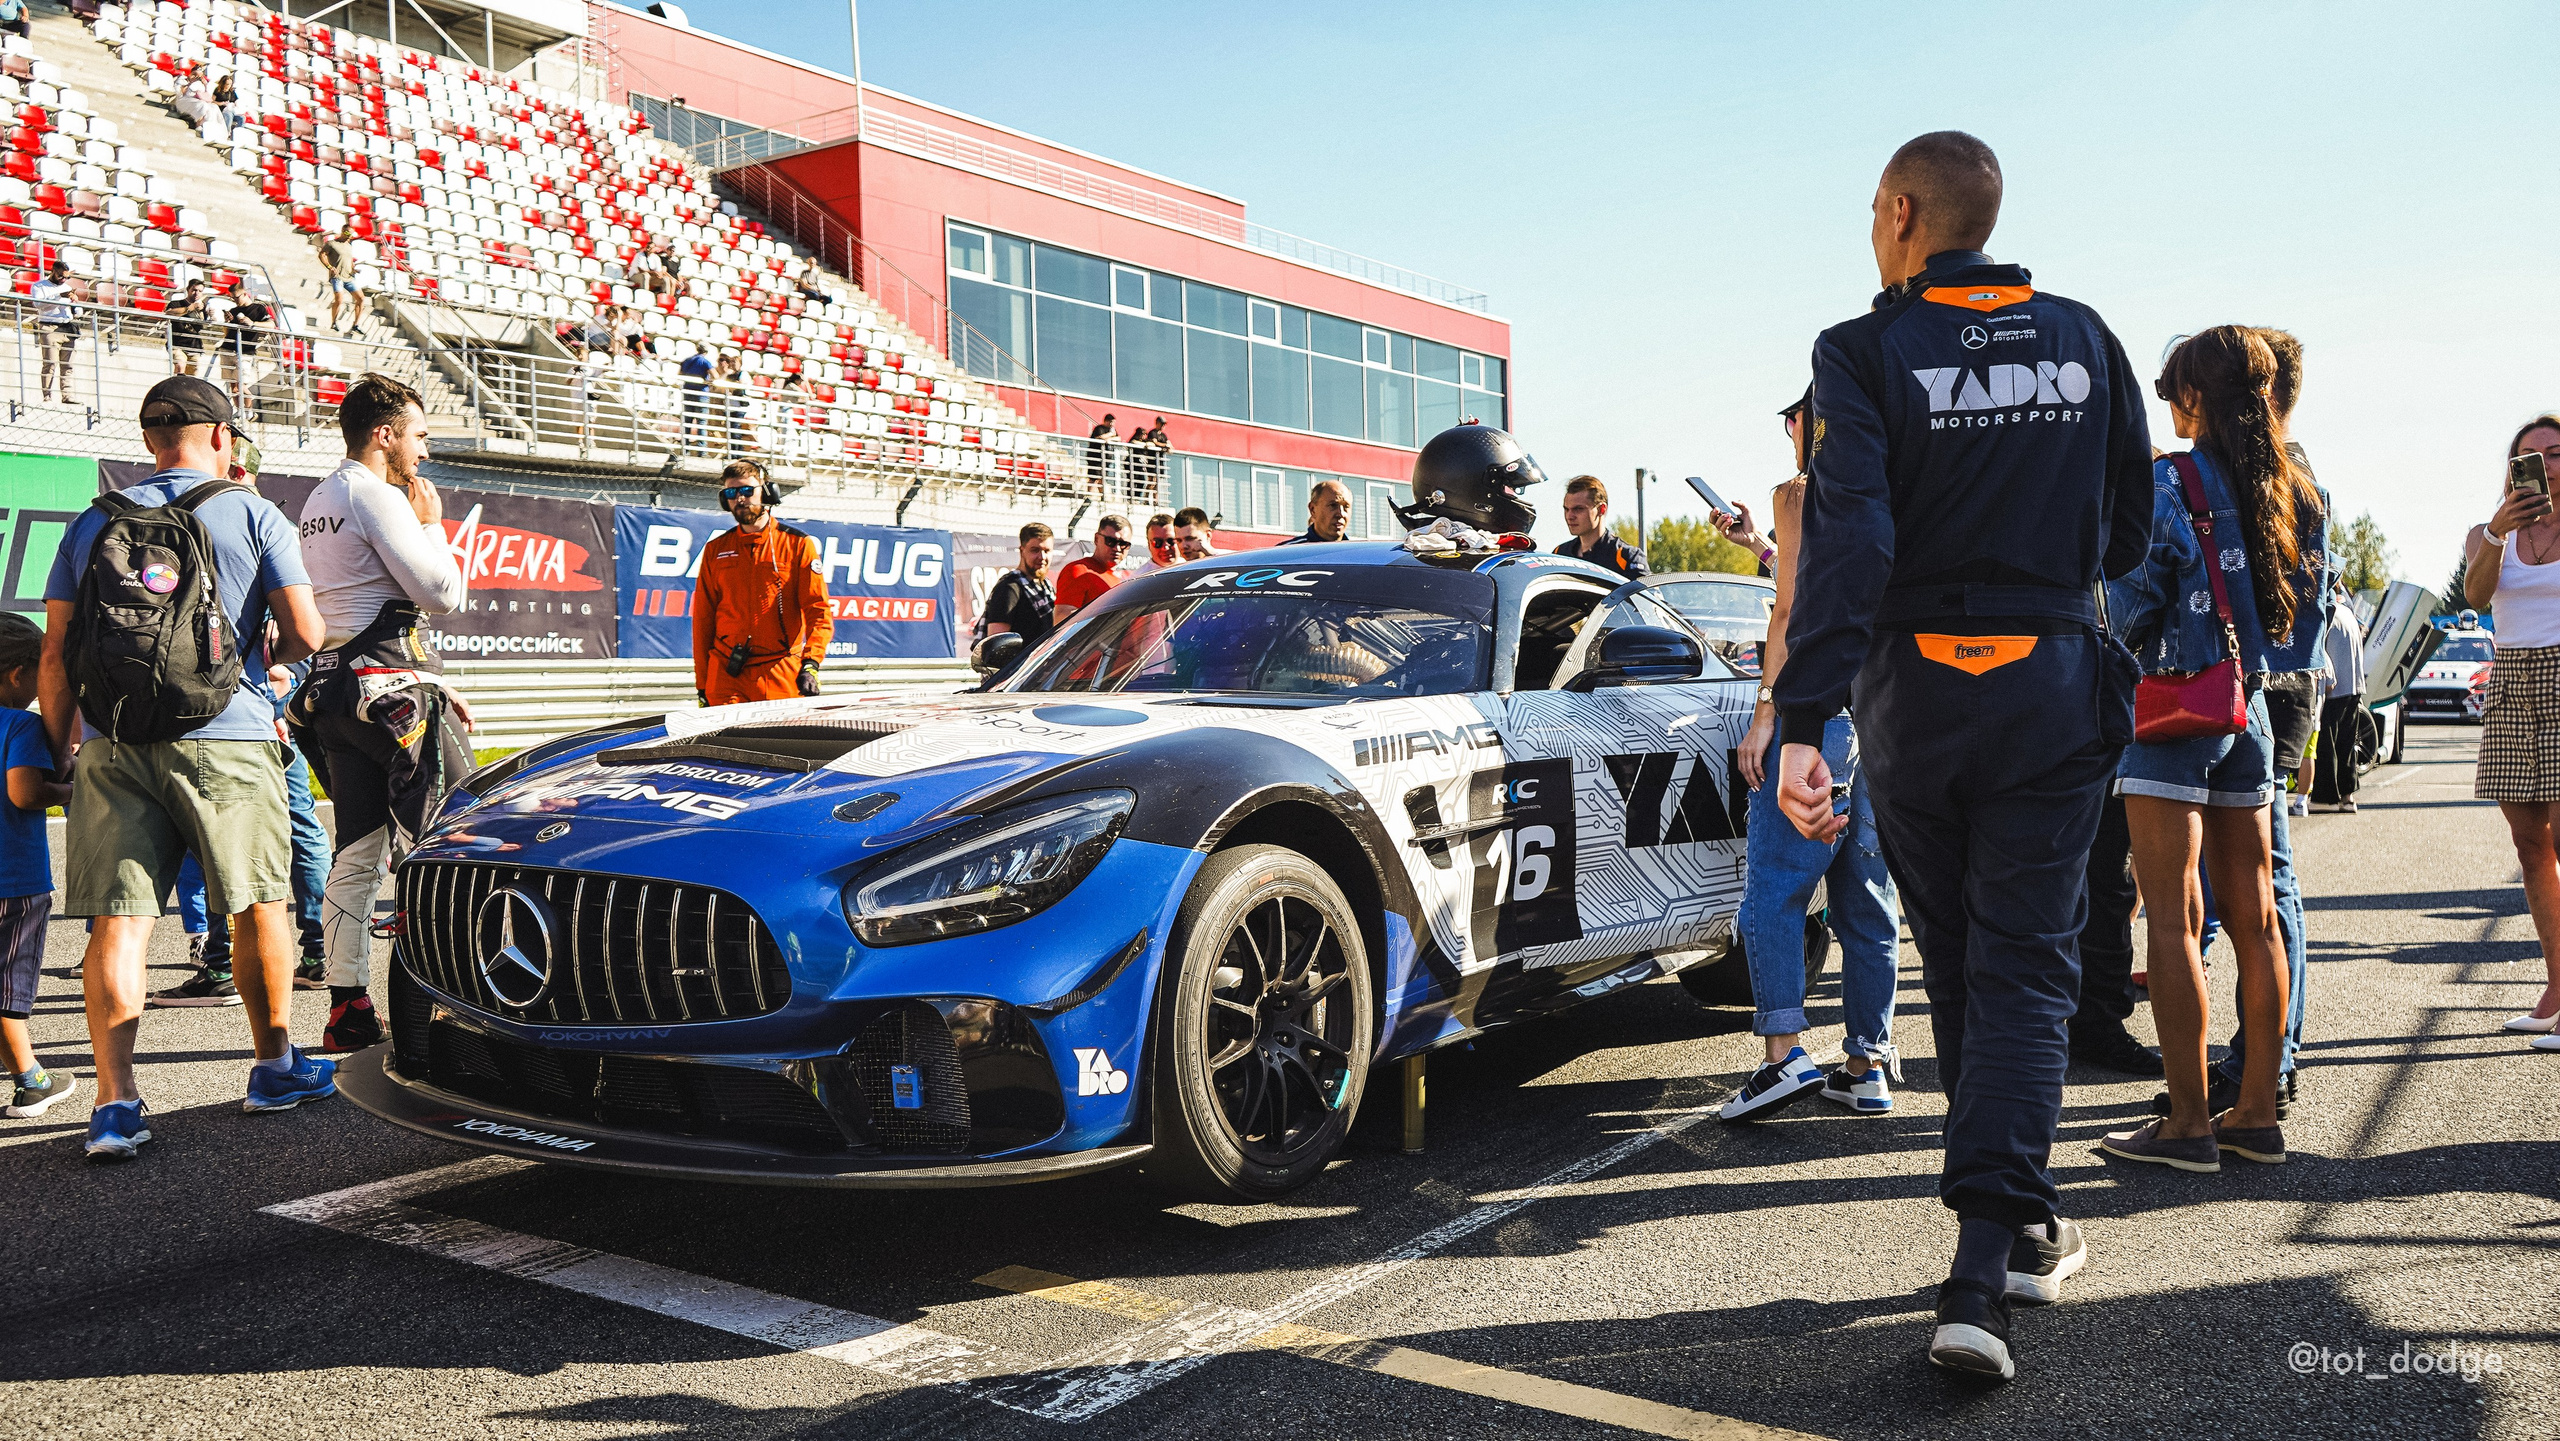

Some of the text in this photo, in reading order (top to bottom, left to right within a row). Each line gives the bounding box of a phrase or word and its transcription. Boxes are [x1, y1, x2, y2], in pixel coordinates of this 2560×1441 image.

[1912, 360, 2091, 412] YADRO
[1930, 410, 2084, 430] MOTORSPORT
[450, 503, 566, 613] ARENA
[468, 599, 592, 615] KARTING
[828, 599, 930, 619] RACING
[429, 629, 584, 657] Новороссийск
[1955, 644, 1994, 659] freem
[1485, 824, 1556, 907] 16
[453, 1118, 597, 1152] YOKOHAMA
